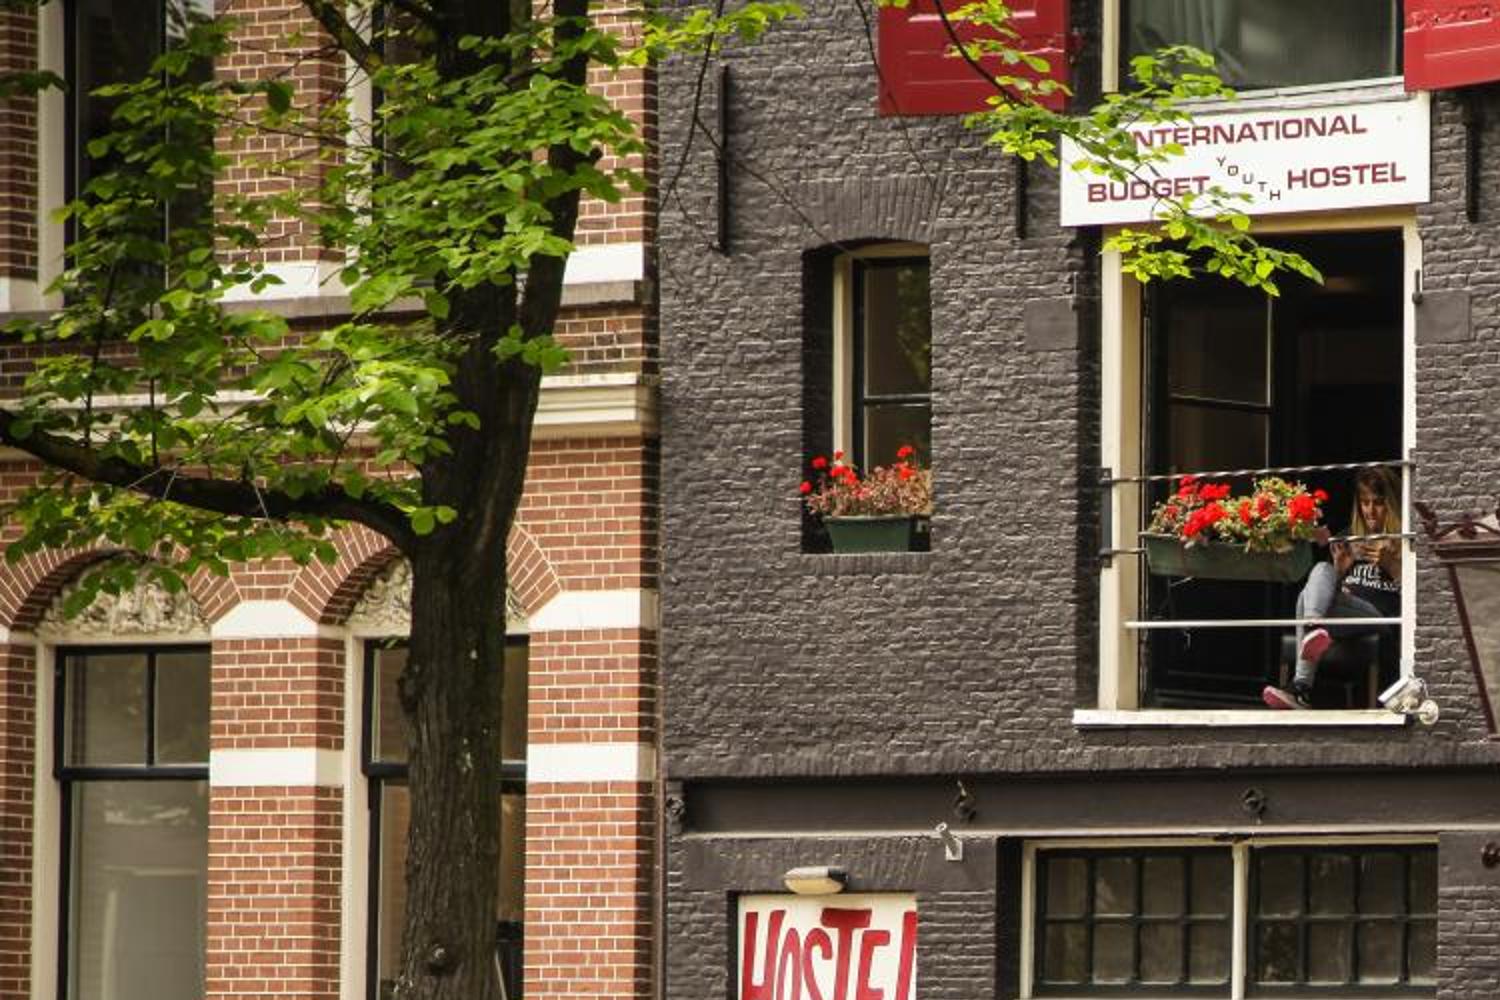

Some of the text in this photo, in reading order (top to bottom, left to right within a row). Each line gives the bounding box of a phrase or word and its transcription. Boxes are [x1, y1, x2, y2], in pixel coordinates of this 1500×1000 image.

[1124, 114, 1367, 148] NTERNATIONAL
[1087, 156, 1406, 202] BUDGET YOUTH HOSTEL
